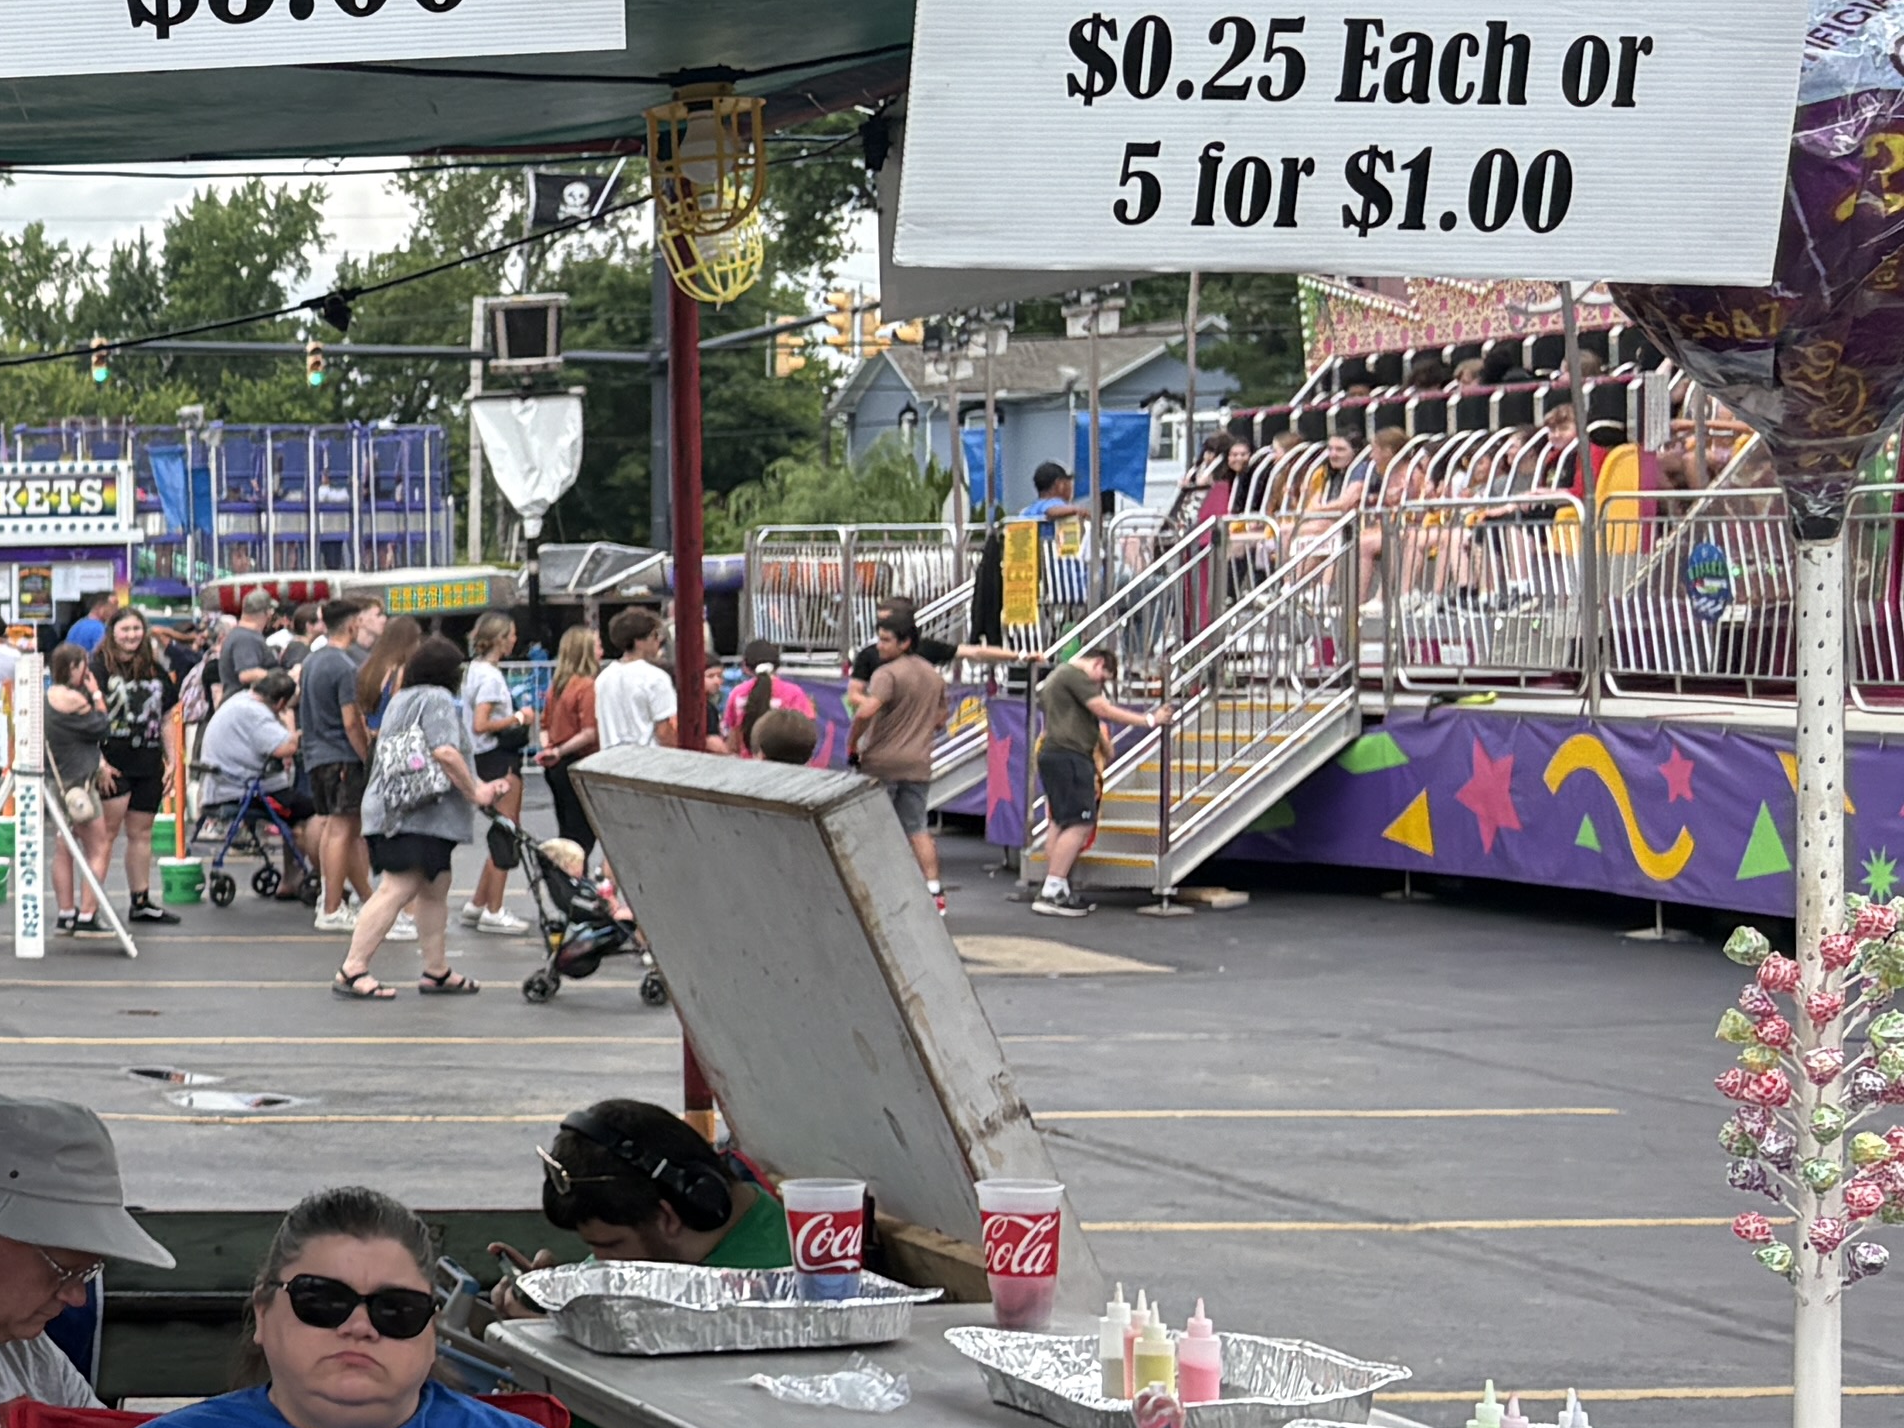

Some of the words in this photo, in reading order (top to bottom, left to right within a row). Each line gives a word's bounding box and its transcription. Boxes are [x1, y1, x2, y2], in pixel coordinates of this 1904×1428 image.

[1066, 13, 1306, 106] $0.25
[1336, 19, 1529, 106] Each
[1562, 32, 1653, 108] or
[1113, 140, 1162, 225] 5
[1193, 142, 1314, 228] for
[1343, 144, 1573, 236] $1.00
